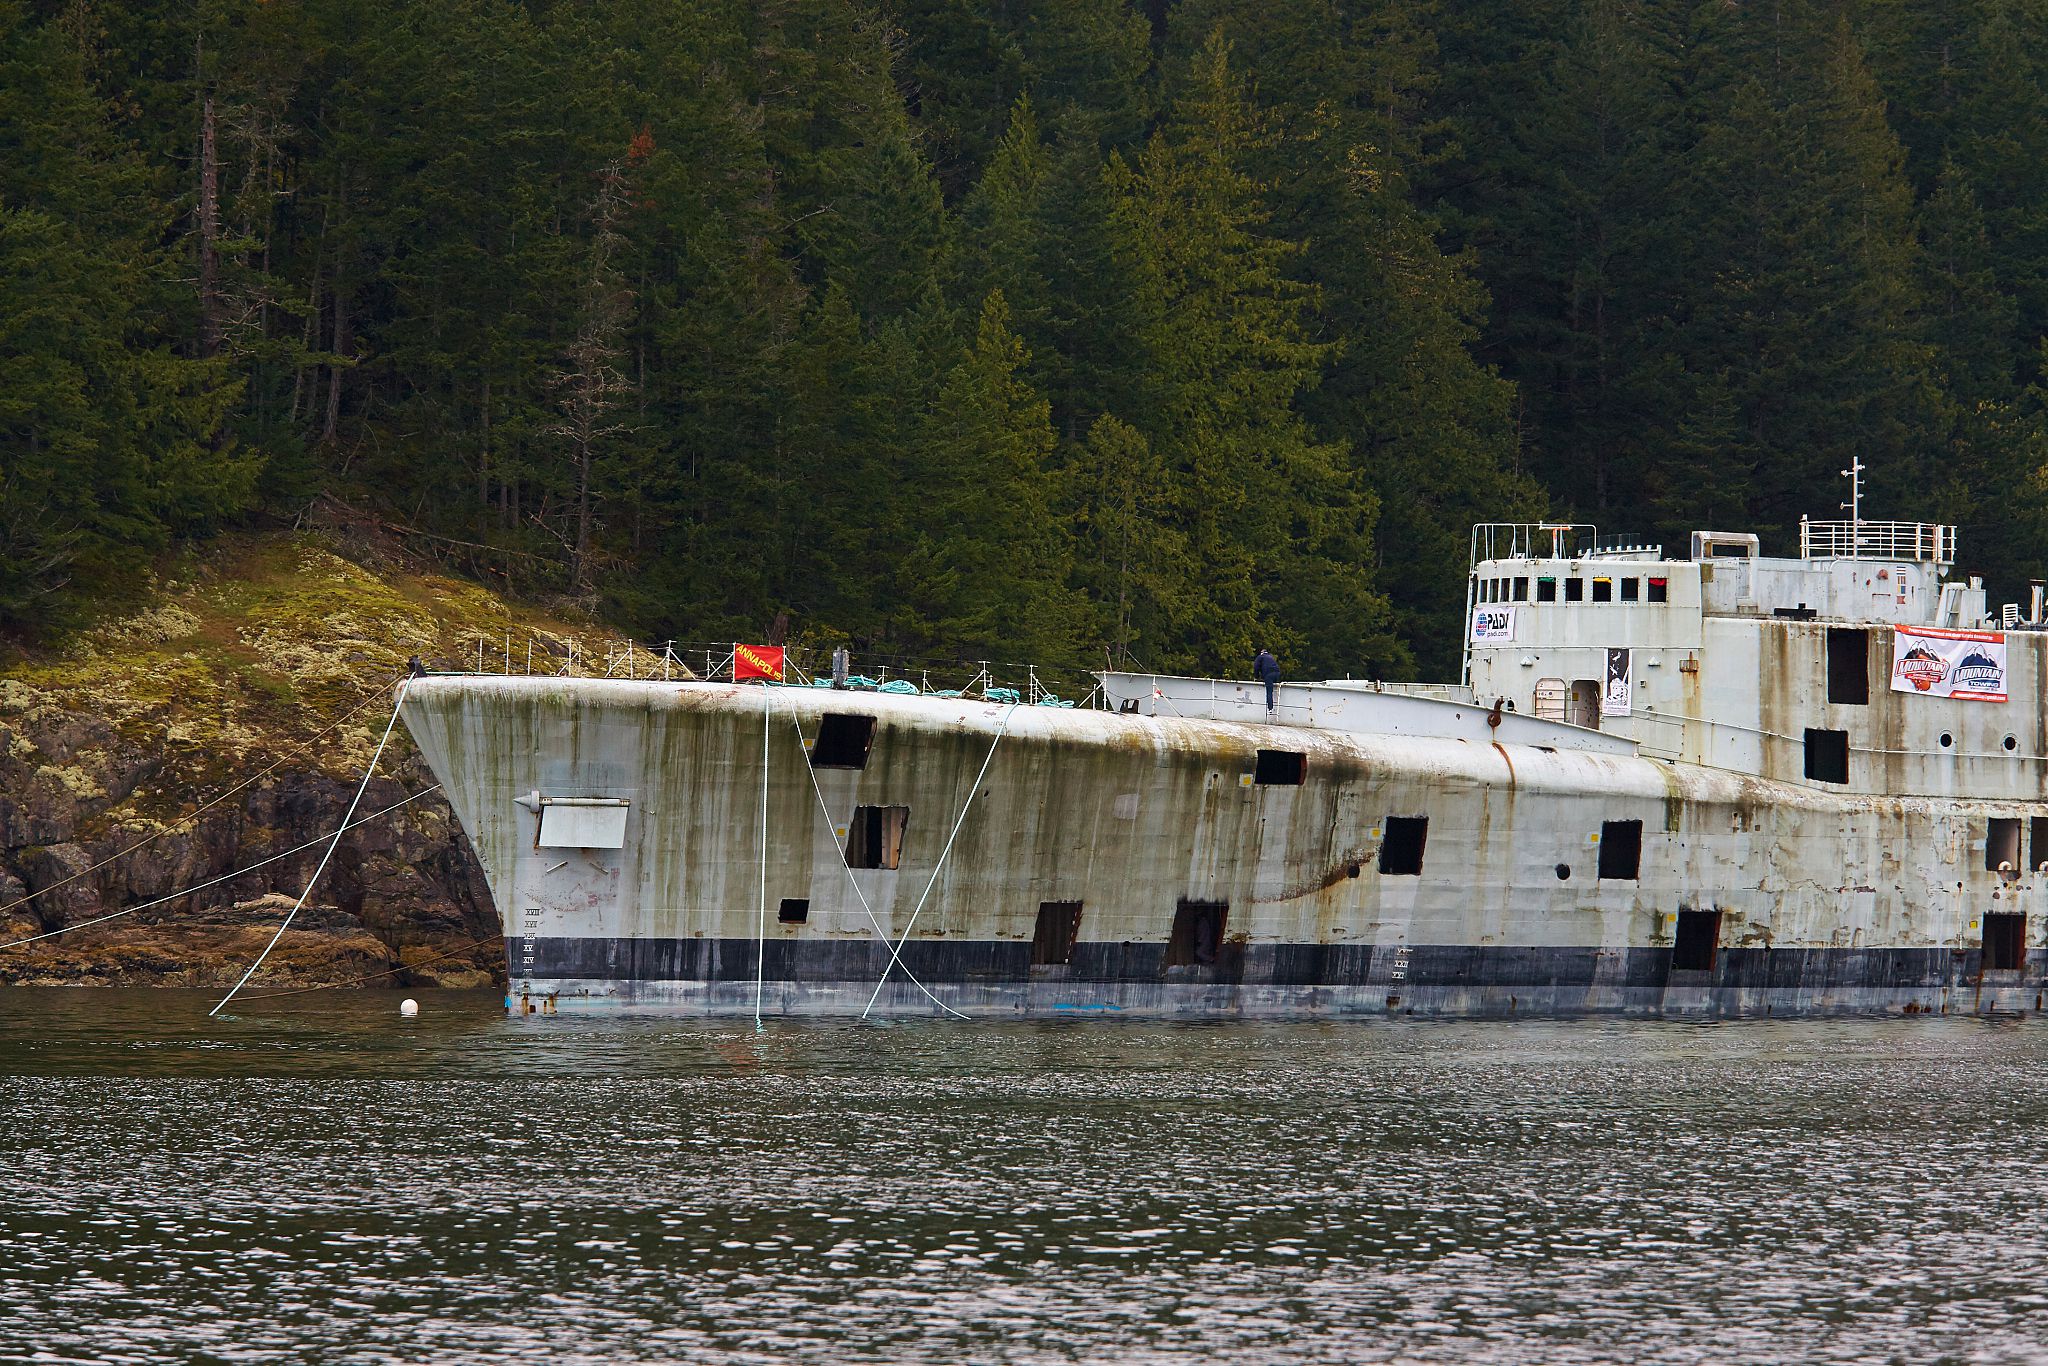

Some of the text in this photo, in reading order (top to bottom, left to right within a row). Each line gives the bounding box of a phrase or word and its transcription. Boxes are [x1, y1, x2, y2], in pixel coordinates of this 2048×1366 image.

[1487, 613, 1509, 630] PADI
[1487, 630, 1509, 638] padi.com
[736, 645, 782, 680] ANNAPOLIS
[1898, 660, 1945, 674] MOUNTAIN
[1955, 667, 2003, 683] MOUNTAIN
